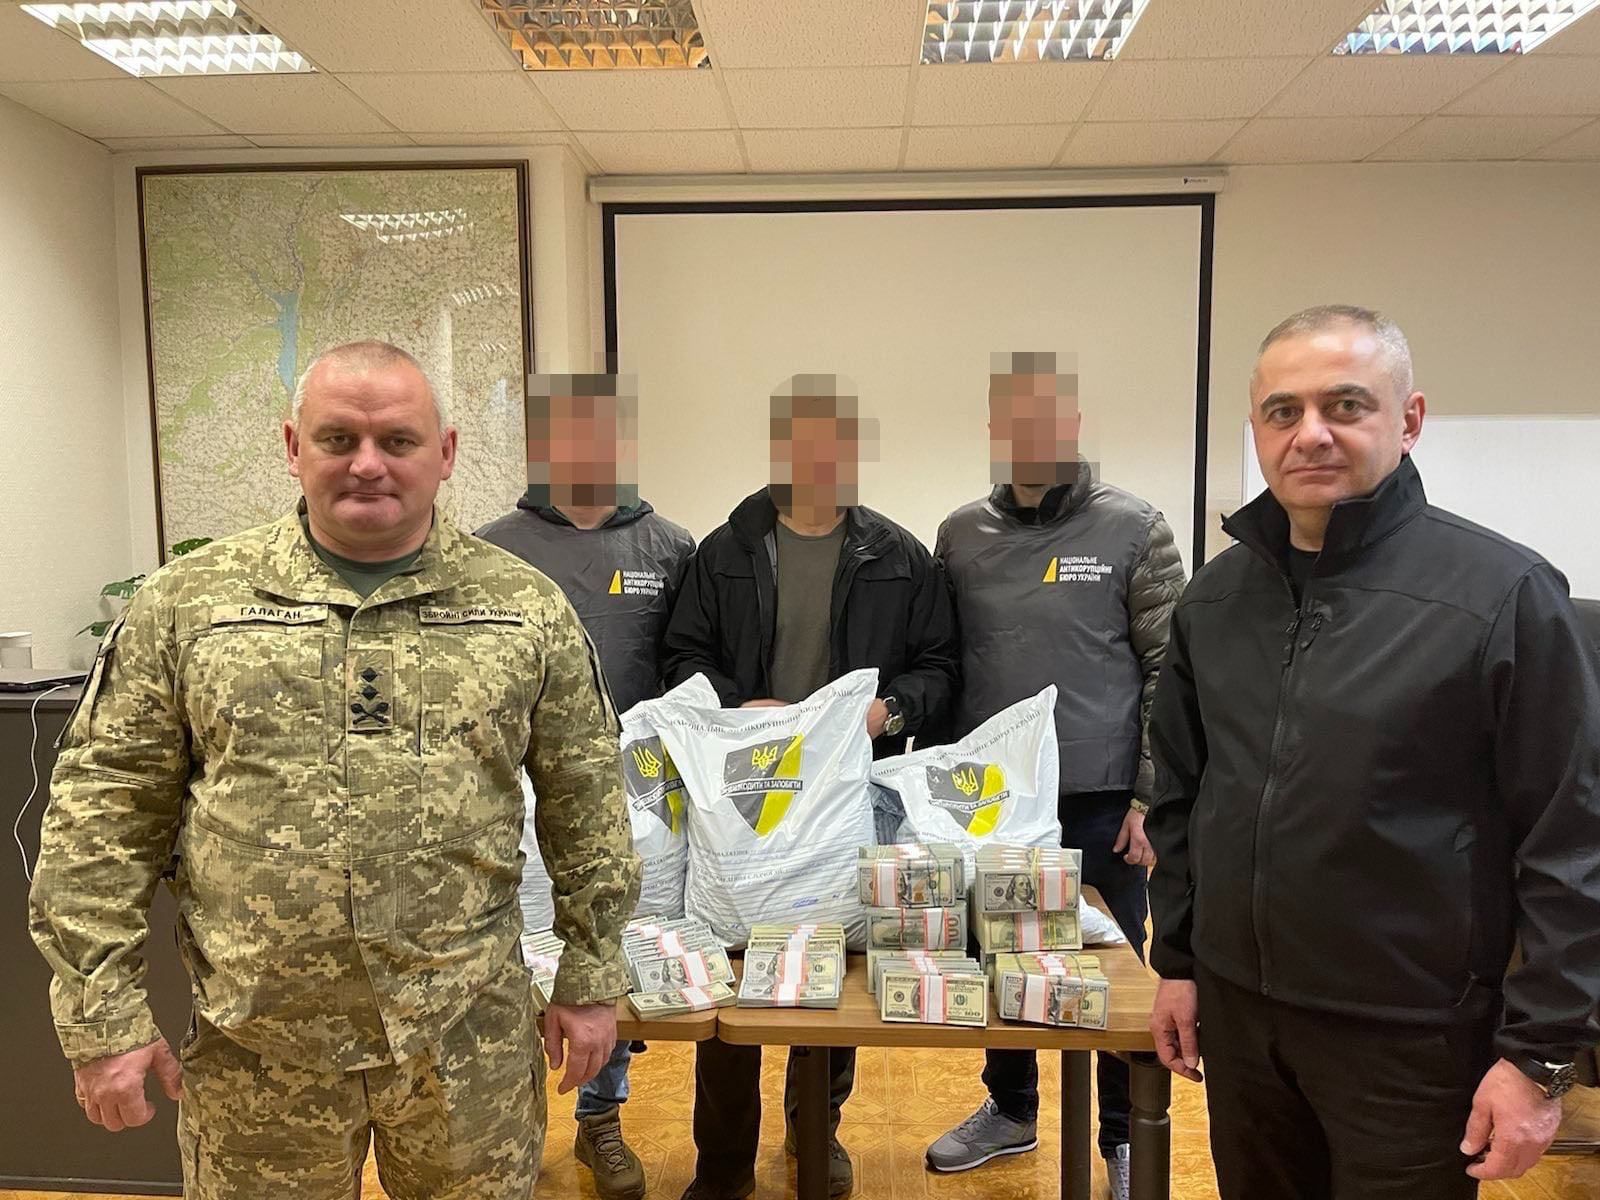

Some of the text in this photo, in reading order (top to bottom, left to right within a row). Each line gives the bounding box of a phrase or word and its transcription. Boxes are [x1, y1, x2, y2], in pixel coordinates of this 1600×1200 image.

[1060, 564, 1112, 574] АНТИКОРУПЦІЙНЕ
[1059, 573, 1101, 582] БЮРО УКРАЇНИ
[240, 607, 300, 620] ГАЛАГАН
[462, 608, 486, 618] СИЛИ
[489, 608, 522, 619] УКРАЇНИ
